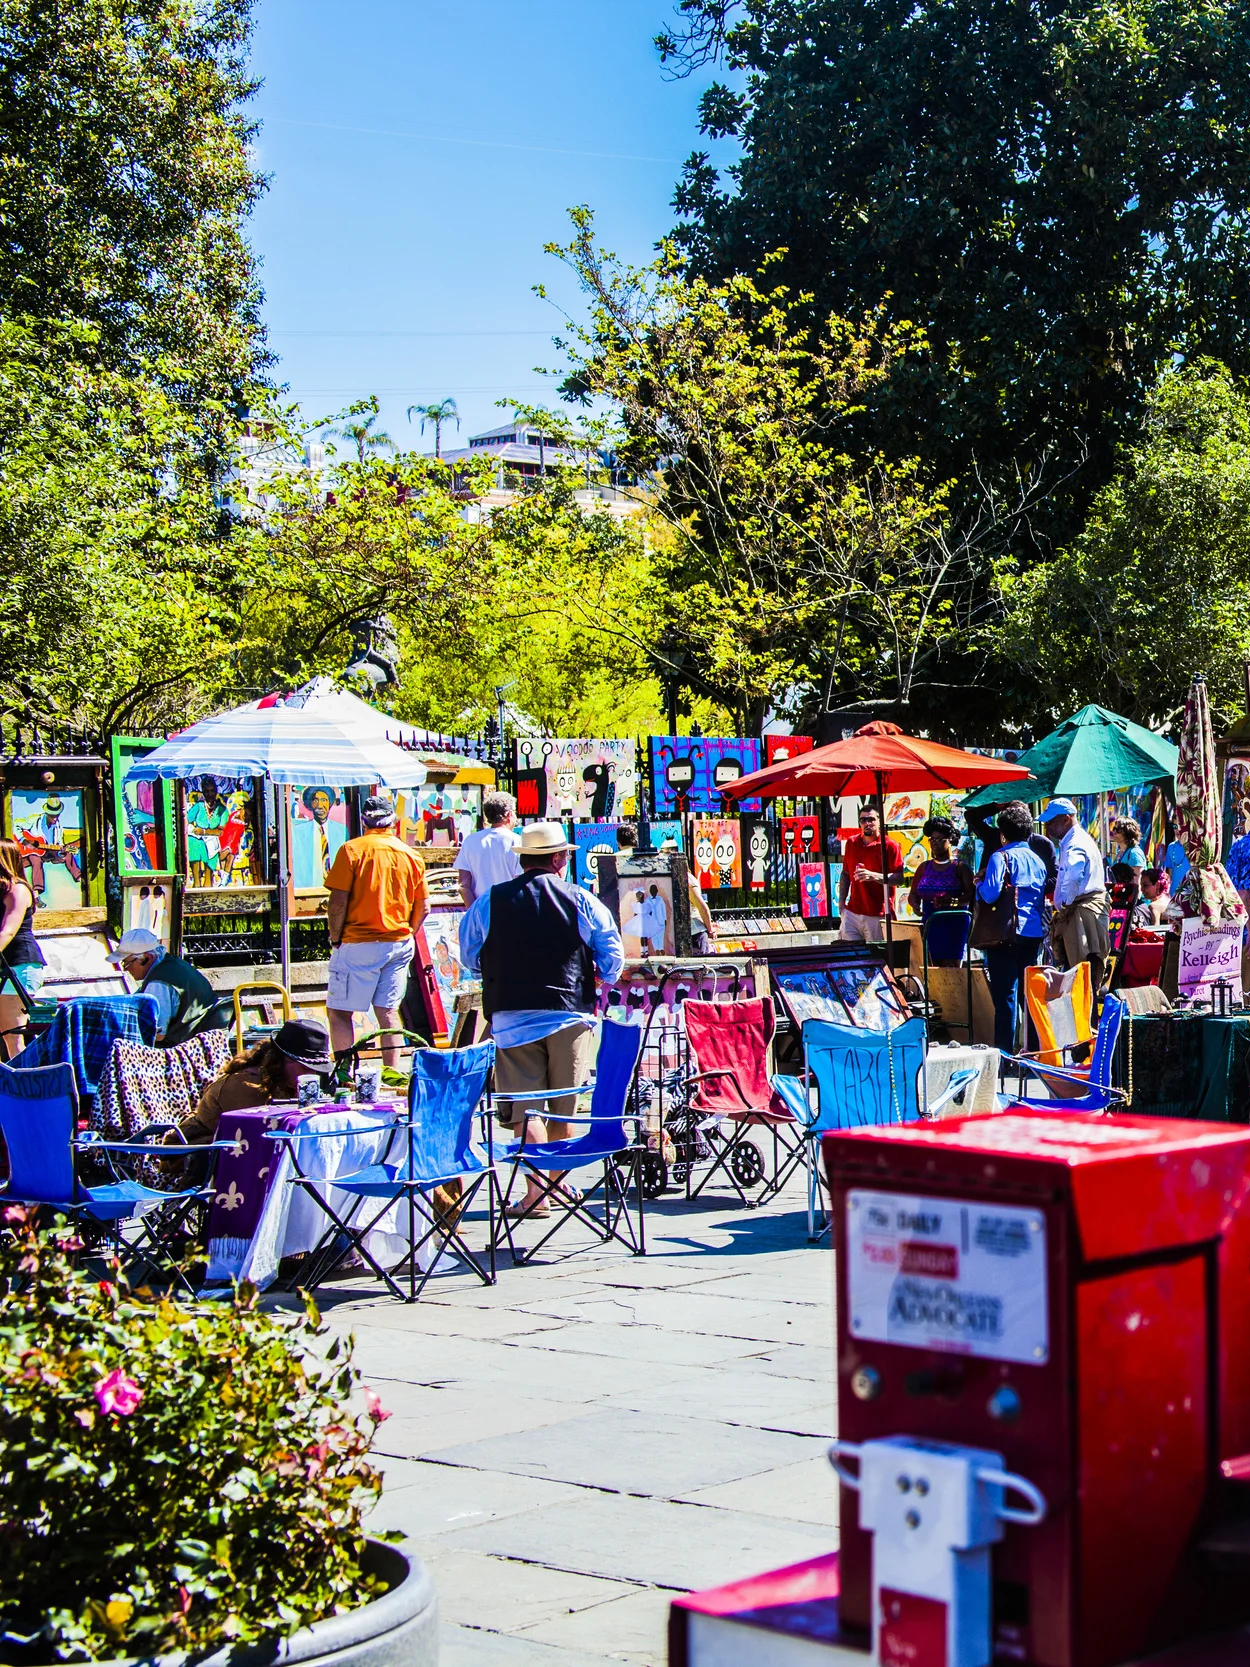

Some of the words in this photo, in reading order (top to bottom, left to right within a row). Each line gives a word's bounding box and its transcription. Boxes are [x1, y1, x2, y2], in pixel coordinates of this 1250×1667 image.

[600, 740, 626, 754] PARTY
[1183, 928, 1208, 946] Psychic
[1209, 923, 1241, 940] Readings
[1181, 944, 1239, 967] Kelleigh
[890, 1297, 1004, 1337] ADVOCATE
